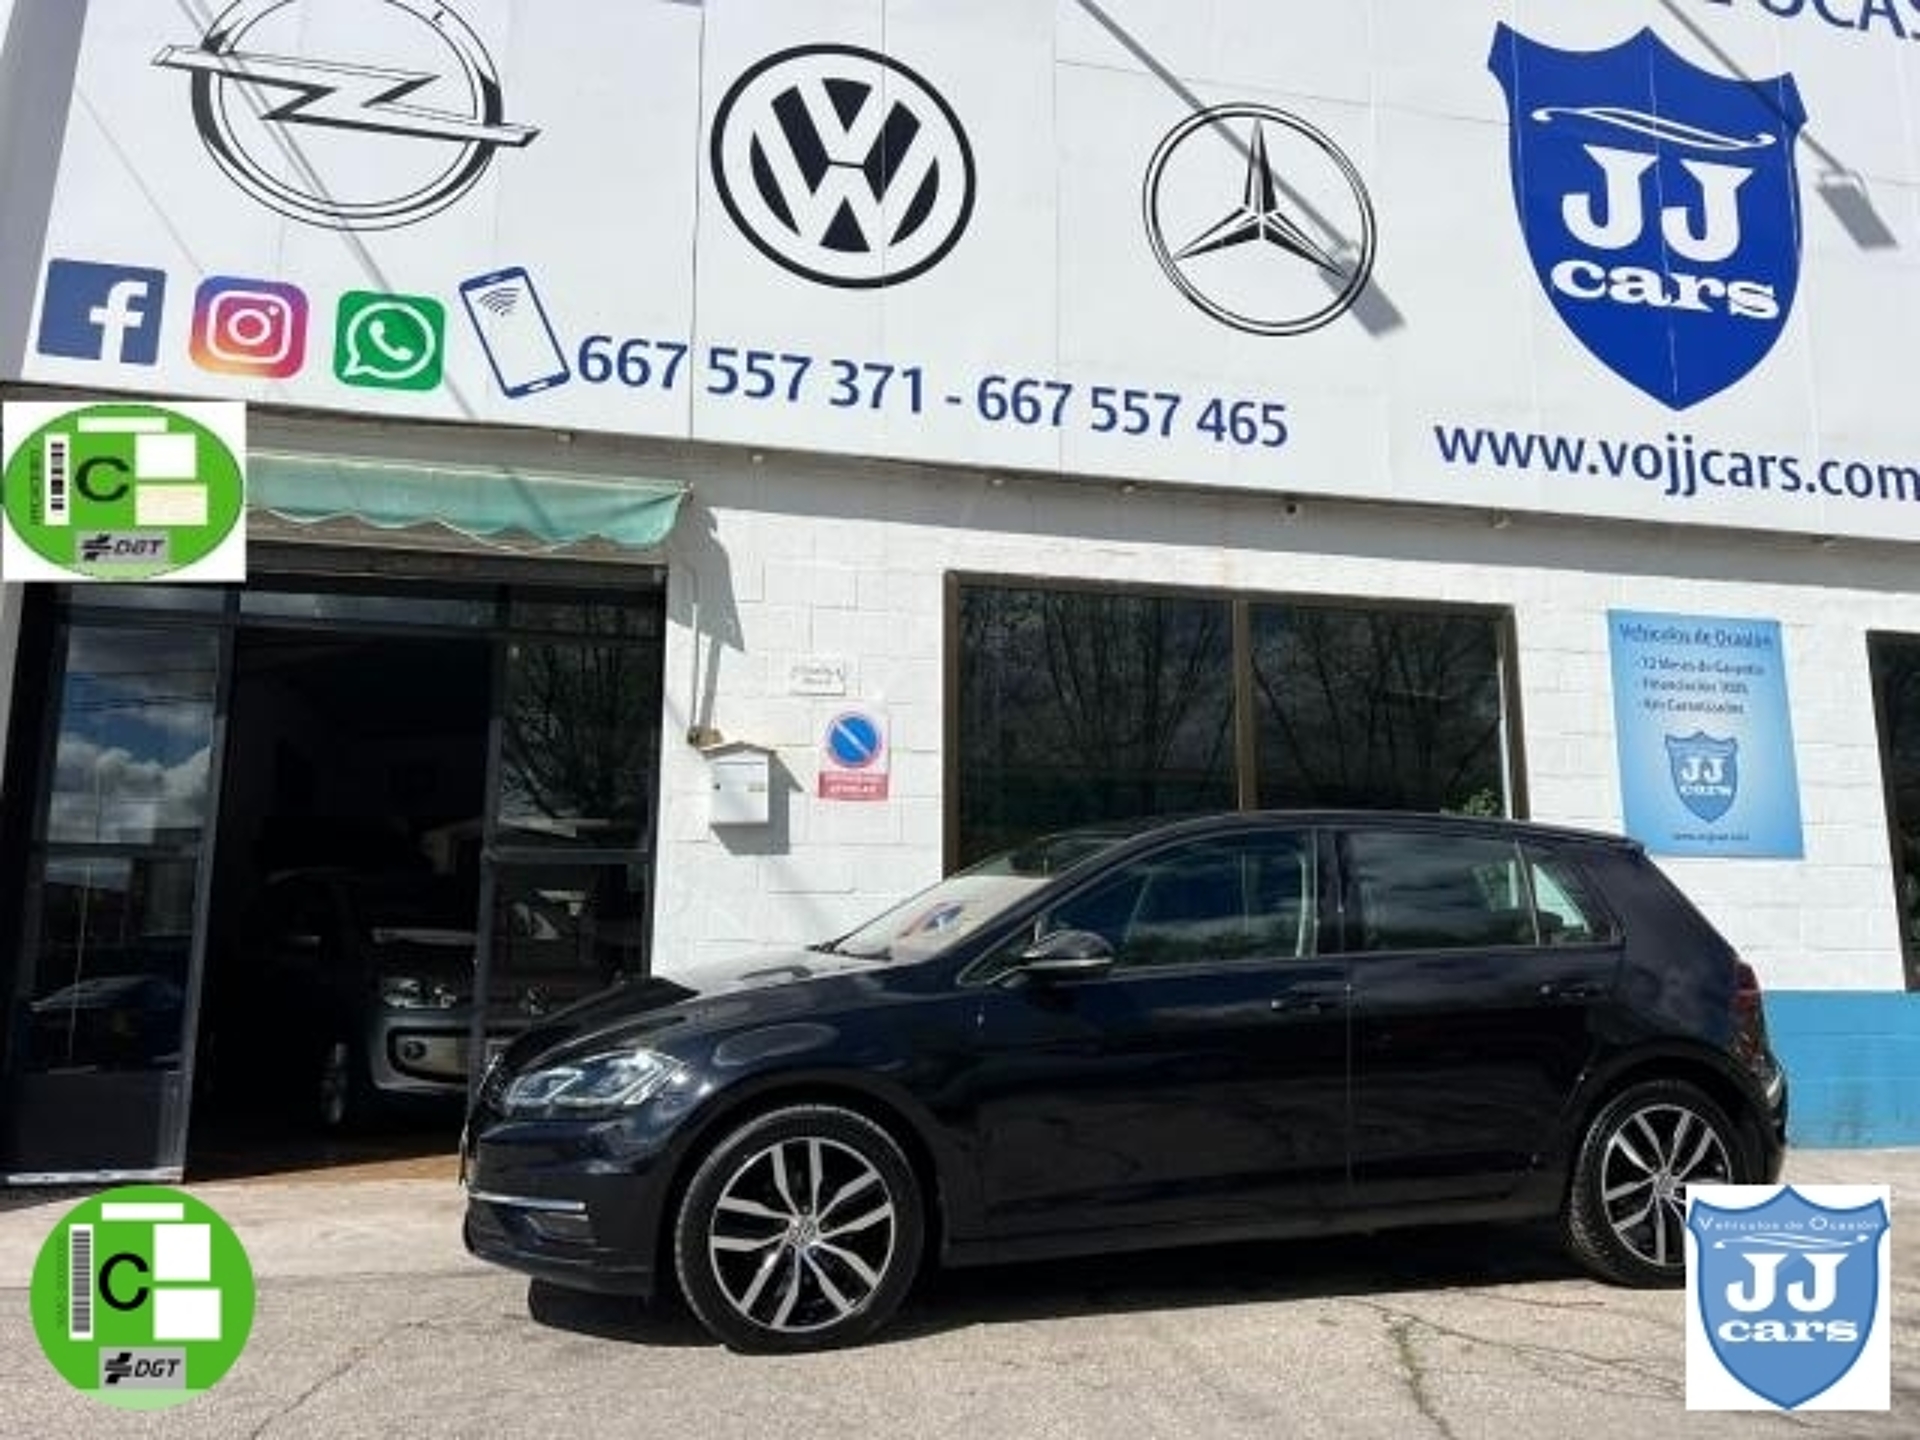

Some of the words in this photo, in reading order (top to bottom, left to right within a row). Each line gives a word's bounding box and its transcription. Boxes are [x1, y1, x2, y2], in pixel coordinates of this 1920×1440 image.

[1562, 143, 1755, 263] JJ
[1550, 259, 1780, 320] cars
[577, 334, 688, 389] 667
[706, 347, 812, 401] 557
[829, 359, 923, 413] 371
[976, 375, 1073, 427] 667
[1090, 386, 1181, 437] 557
[1196, 398, 1289, 448] 465
[1433, 424, 1920, 502] www.vojjcars.com
[1681, 757, 1728, 784] JJ
